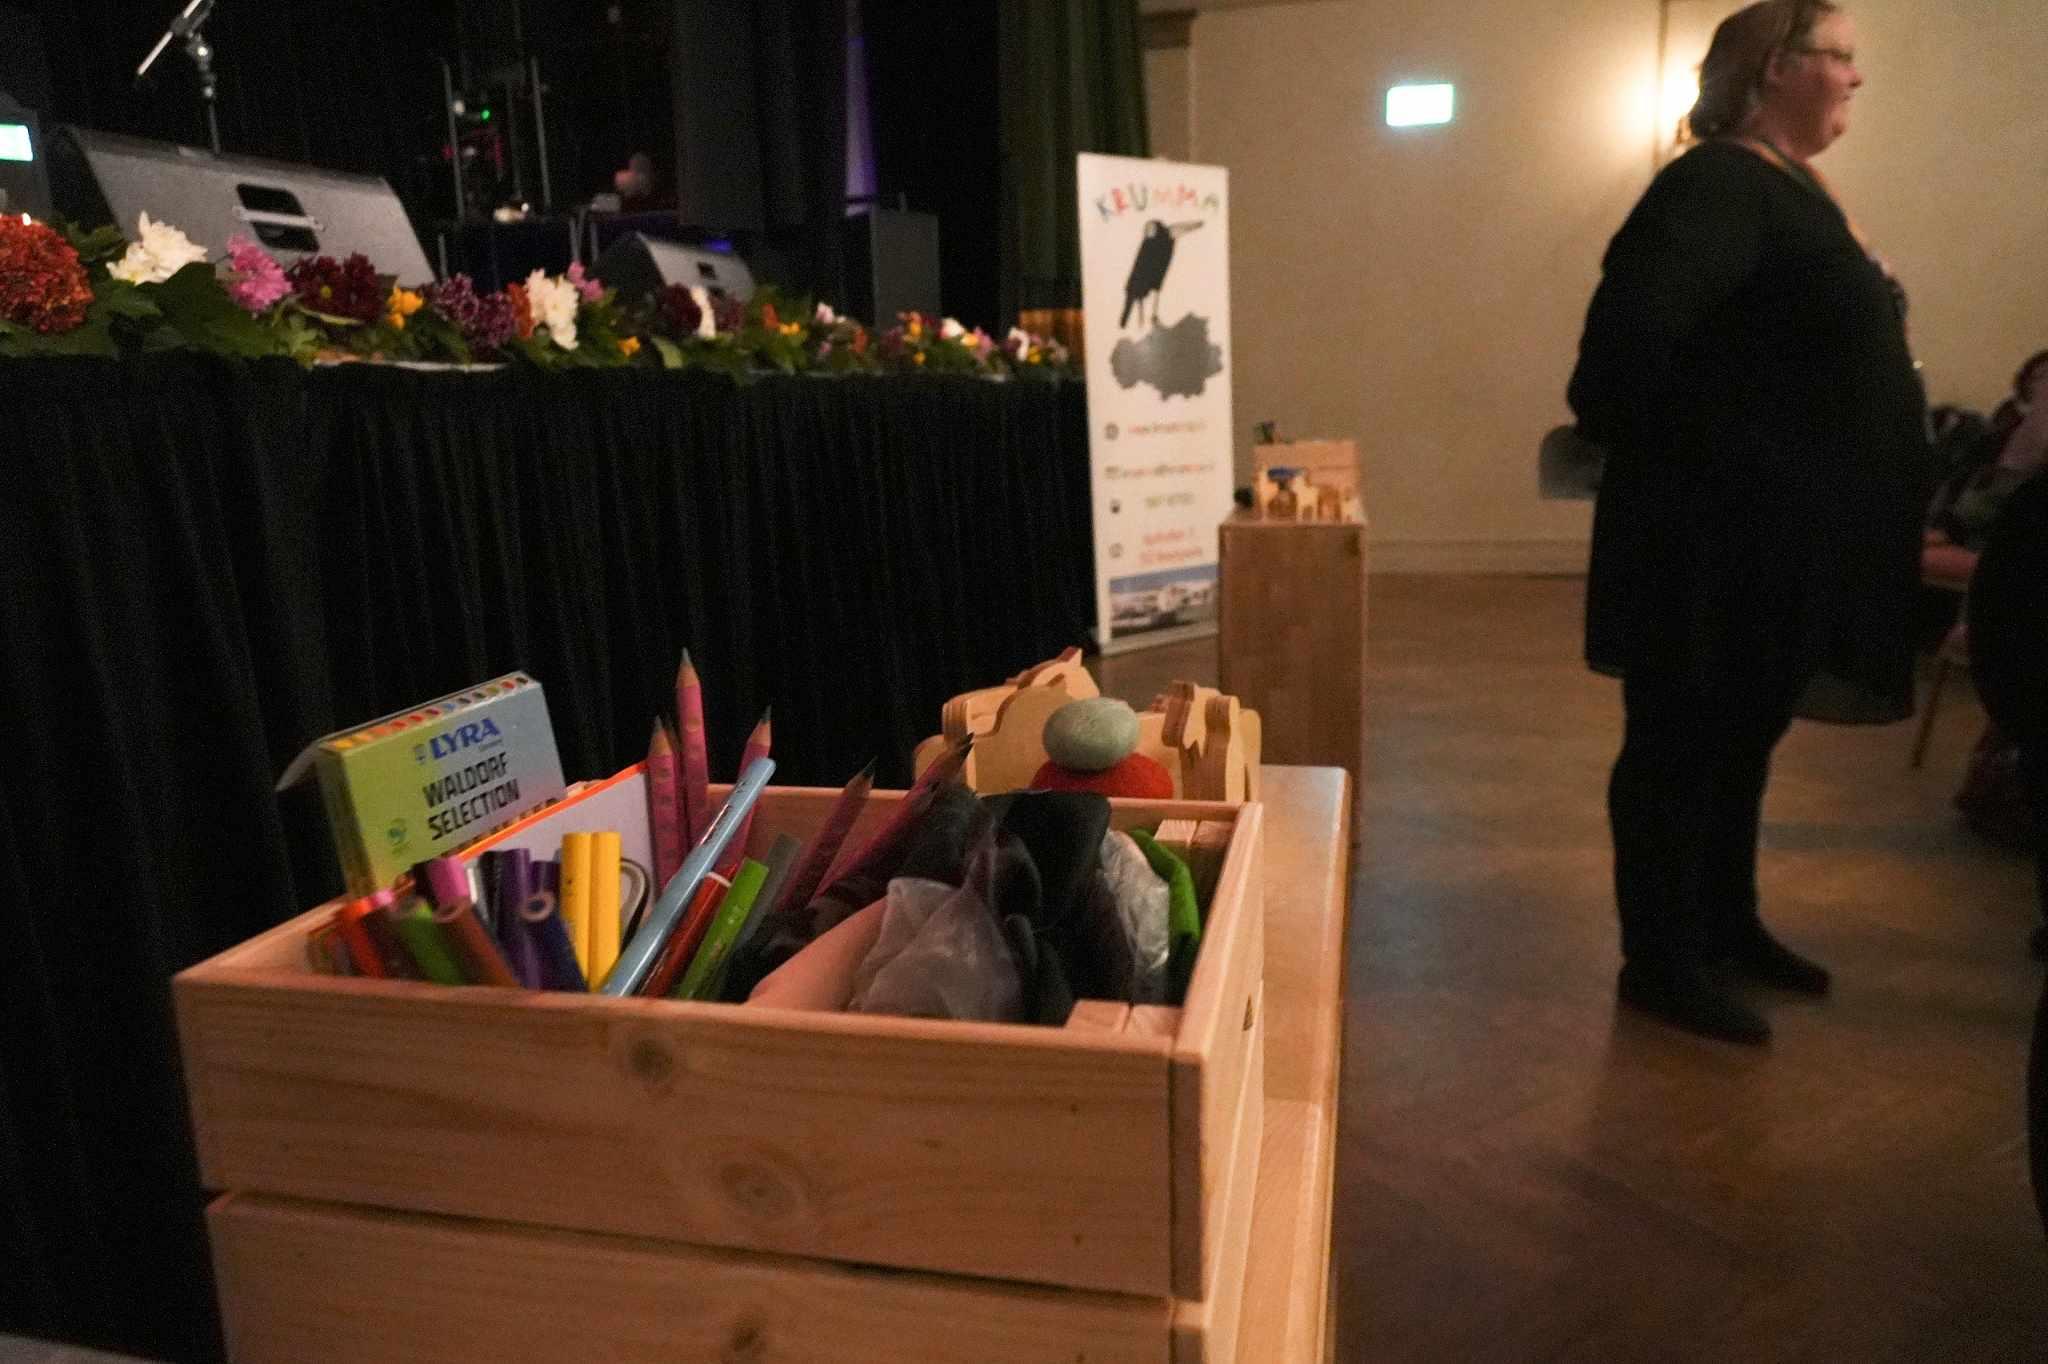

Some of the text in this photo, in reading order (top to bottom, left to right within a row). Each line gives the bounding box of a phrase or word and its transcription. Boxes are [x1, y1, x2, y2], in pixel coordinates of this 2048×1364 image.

[430, 717, 501, 759] LYRA
[422, 752, 508, 808] WALDORF
[428, 778, 520, 841] SELECTION
